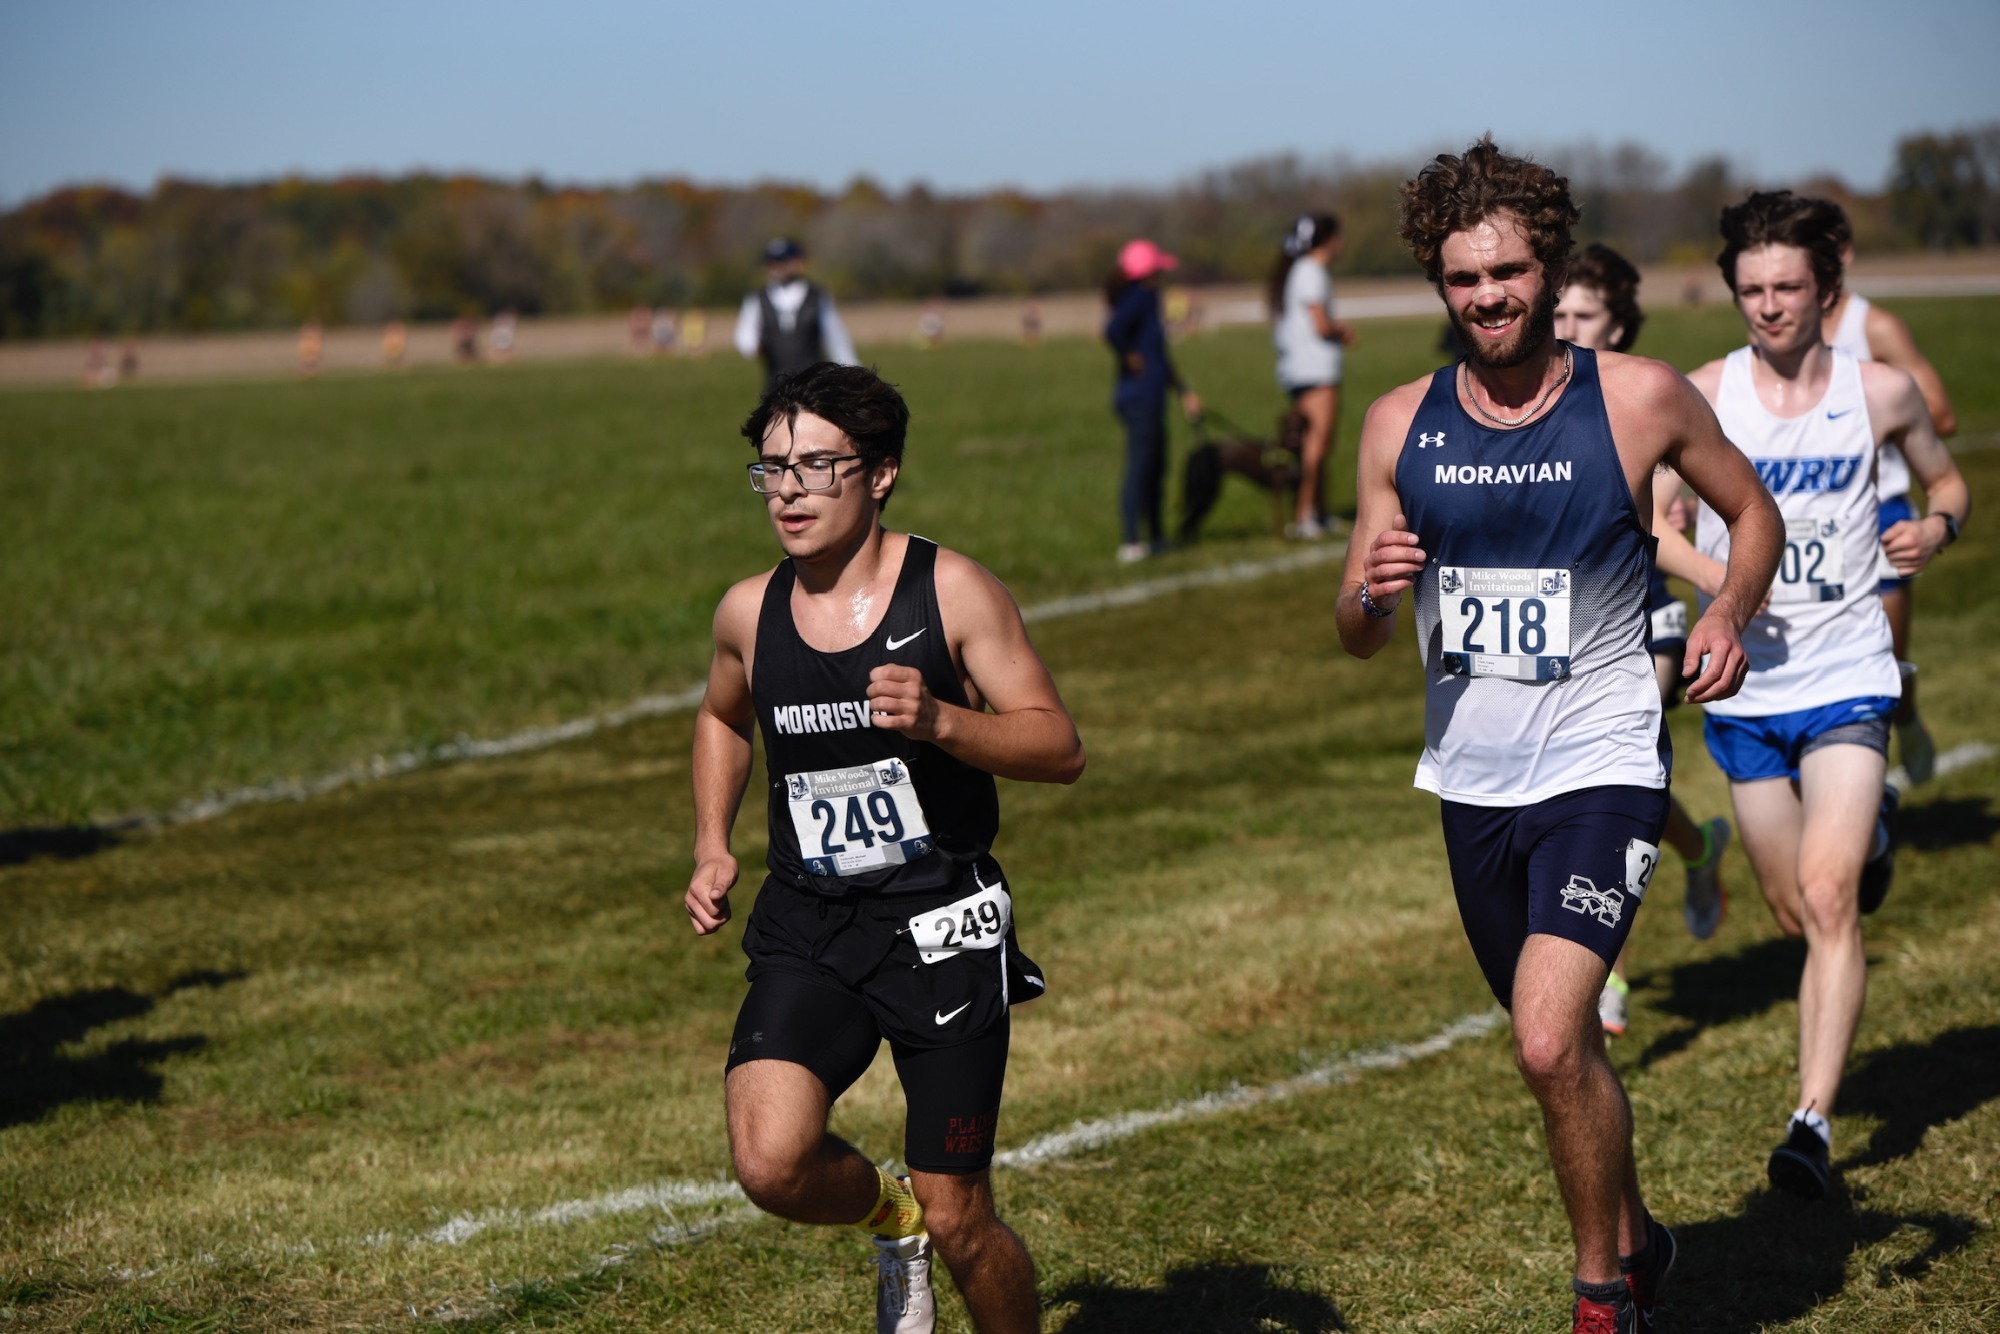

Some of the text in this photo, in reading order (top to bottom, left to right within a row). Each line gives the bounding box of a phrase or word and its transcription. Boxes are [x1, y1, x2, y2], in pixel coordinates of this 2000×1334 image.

[1434, 461, 1572, 484] MORAVIAN
[1752, 455, 1864, 494] WRU
[1471, 571, 1532, 581] Mike Woods
[1780, 539, 1826, 584] 02
[1469, 582, 1535, 592] Invitational
[1460, 597, 1547, 655] 218
[773, 700, 887, 735] MORRISV
[814, 768, 870, 784] Mike Woods
[814, 777, 876, 795] Invitational
[811, 790, 905, 855] 249
[1638, 853, 1655, 889] 2
[934, 900, 1001, 948] 249
